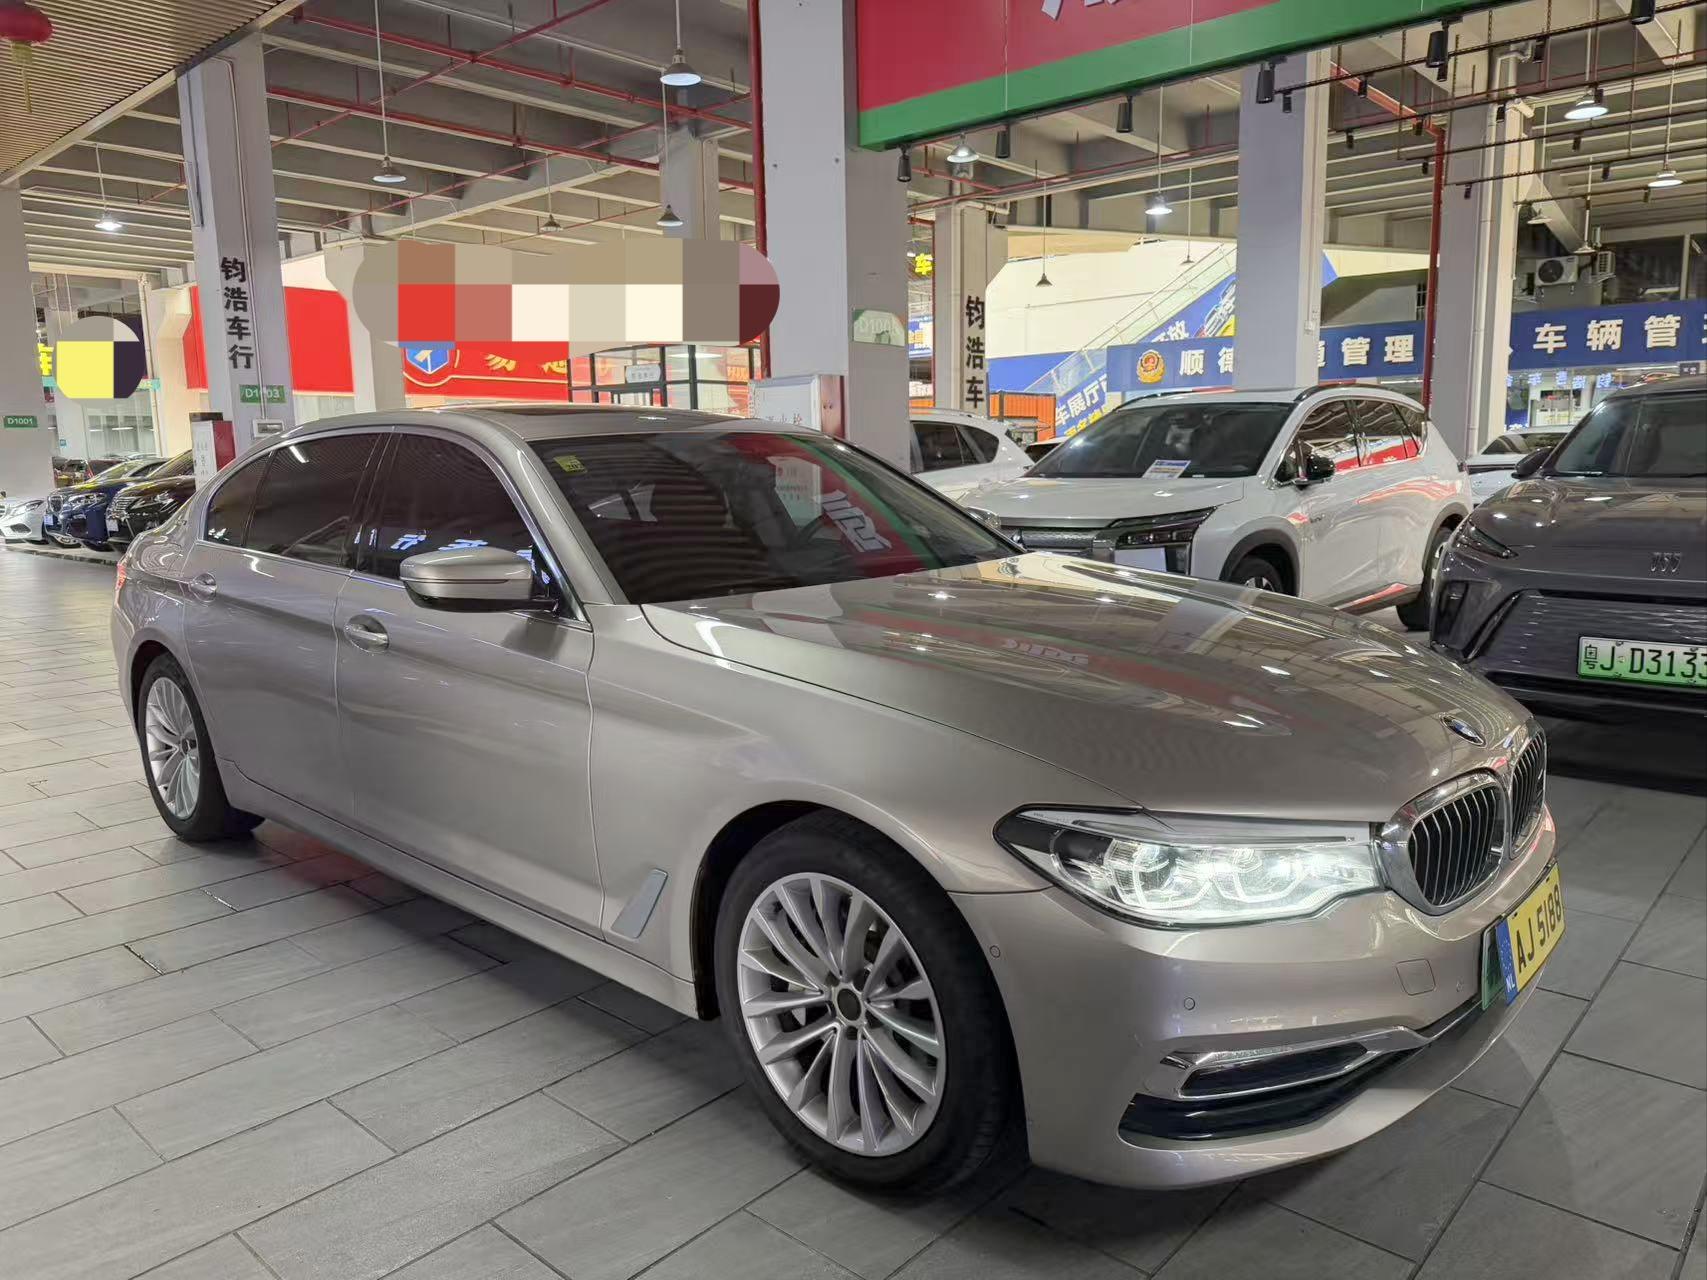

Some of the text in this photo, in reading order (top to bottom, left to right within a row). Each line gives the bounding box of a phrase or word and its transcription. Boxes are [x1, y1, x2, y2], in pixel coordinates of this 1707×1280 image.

[220, 256, 255, 370] 钧浩车行
[1318, 334, 1415, 368] 管理
[1533, 314, 1707, 354] 车辆管
[965, 294, 986, 410] 钧浩车
[245, 388, 281, 400] D103
[8, 417, 33, 426] D1001
[1506, 974, 1516, 993] NL
